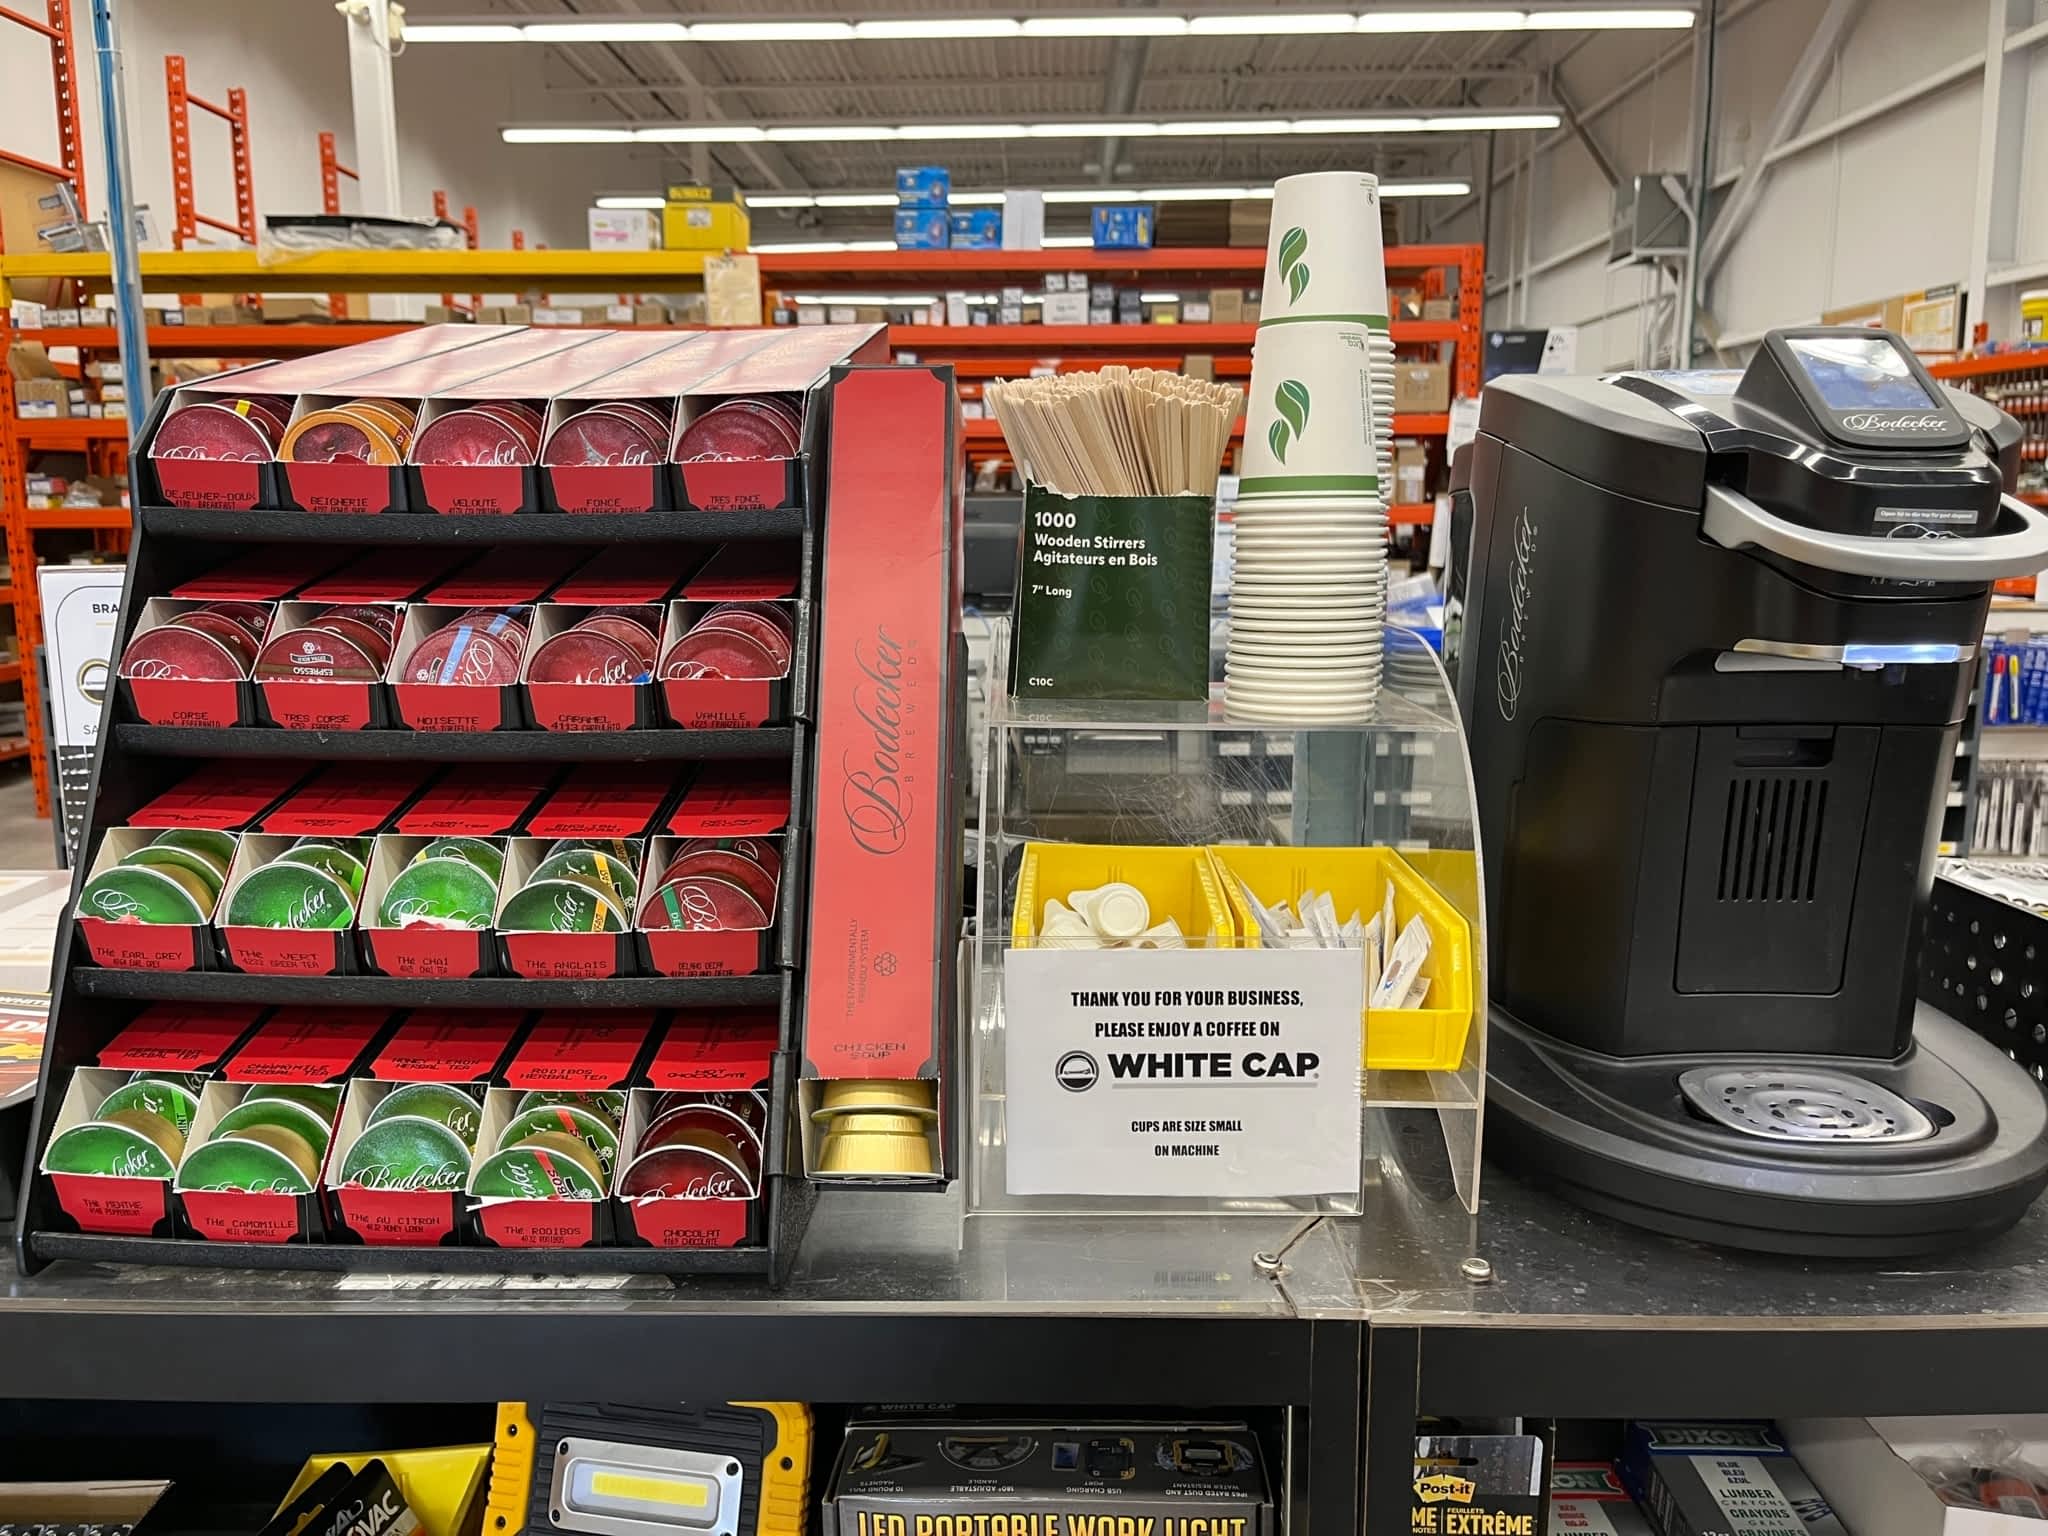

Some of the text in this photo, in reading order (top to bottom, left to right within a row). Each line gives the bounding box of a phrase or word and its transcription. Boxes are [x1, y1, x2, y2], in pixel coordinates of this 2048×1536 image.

[1843, 413, 1949, 432] Bodecker
[1034, 512, 1077, 528] 1000
[1034, 533, 1146, 549] Wooden Stirrers
[1033, 550, 1158, 566] Agitateurs en Bois
[1046, 586, 1072, 598] Long
[1496, 506, 1532, 721] Bodecker
[293, 667, 333, 676] ESPRESSO
[1028, 678, 1054, 686] C10C
[172, 711, 209, 720] CORSE
[283, 713, 311, 722] TRES
[695, 712, 747, 721] VANILLE
[904, 656, 918, 782] BREWED
[842, 624, 913, 855] Bodecker
[122, 950, 148, 960] EARL
[155, 952, 183, 960] GREY
[554, 961, 608, 969] ANGLAIS
[1071, 990, 1304, 1007] THANK YOU FOR YOUR BUSINESS,
[1095, 1020, 1280, 1038] PLEASE ENJOY A COFFEE ON
[833, 1042, 906, 1052] CHICKEN
[850, 1051, 890, 1060] SOUP
[1108, 1052, 1320, 1078] WHITE CAP
[1131, 1120, 1243, 1132] CUPS ARE SIZE SMALL
[1154, 1144, 1220, 1157] ON MACHINE
[232, 1219, 295, 1229] CAMOMILLE
[376, 1216, 391, 1225] AU
[398, 1217, 440, 1225] CITRON
[531, 1227, 581, 1236] ROOIBOS
[663, 1229, 721, 1237] CHOCOLAT
[1660, 1429, 1759, 1444] DIXON
[1420, 1483, 1471, 1494] Post-it
[1719, 1489, 1775, 1498] LUMBER
[1729, 1509, 1790, 1519] CRAYONS
[915, 1514, 1059, 1536] PORTABLE
[1067, 1515, 1155, 1536] WORK
[1446, 1510, 1533, 1535] EXTRÊME
